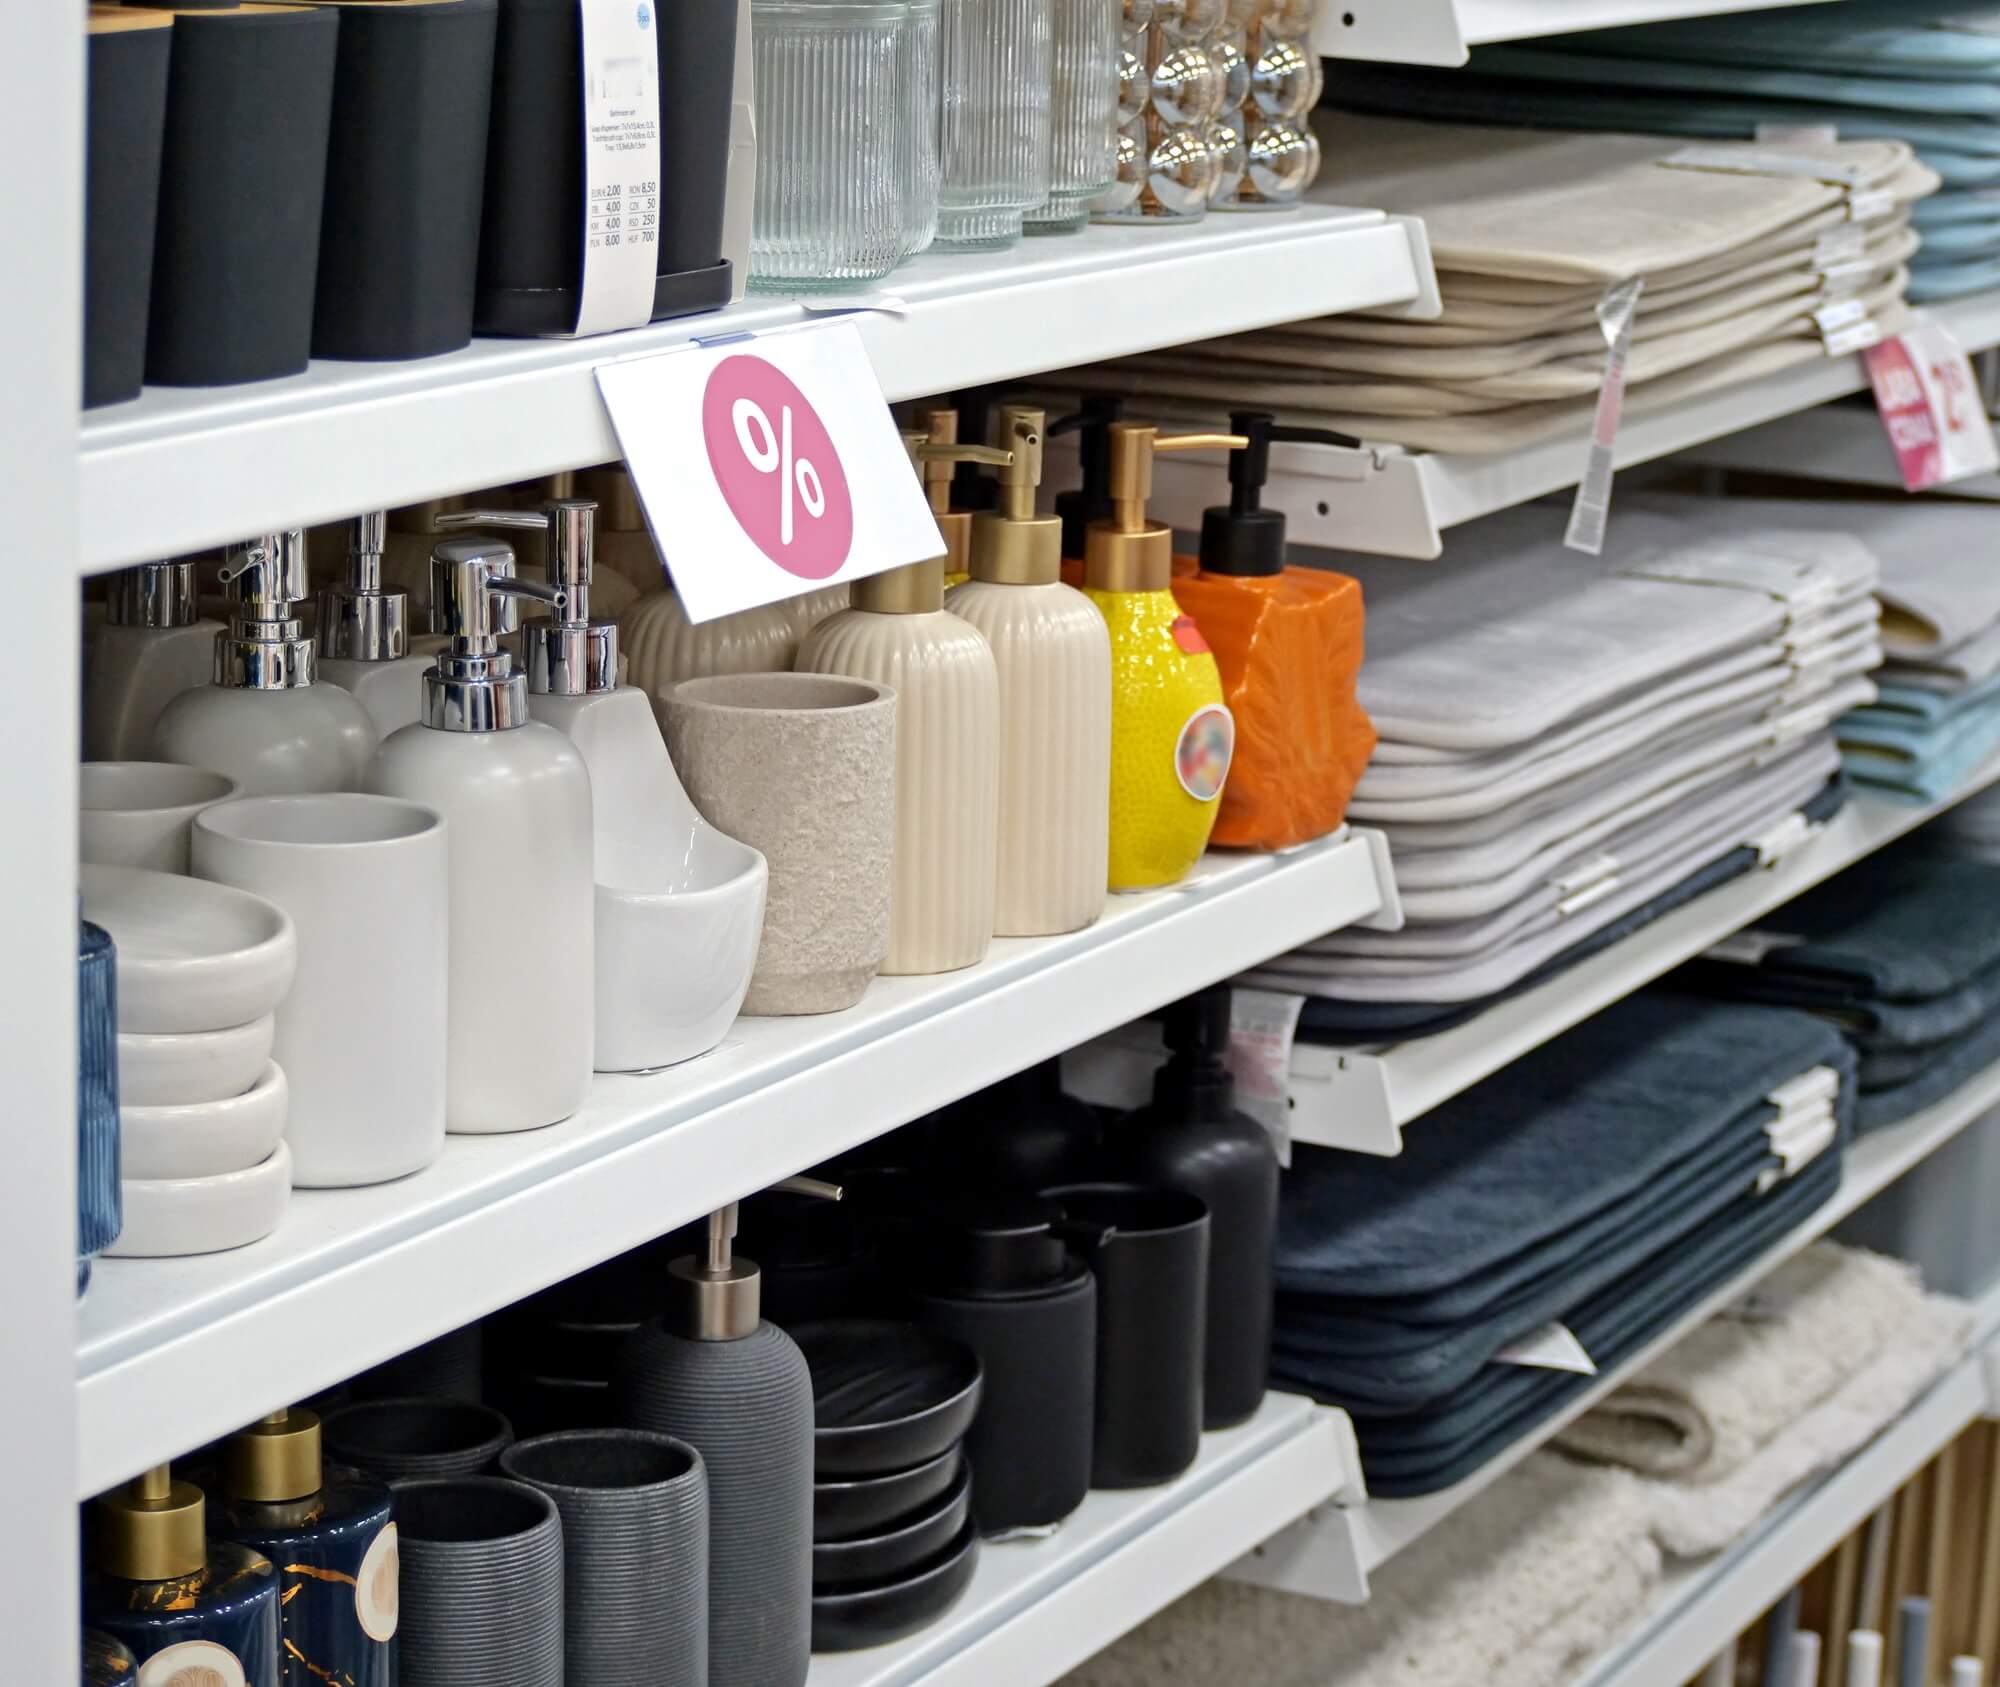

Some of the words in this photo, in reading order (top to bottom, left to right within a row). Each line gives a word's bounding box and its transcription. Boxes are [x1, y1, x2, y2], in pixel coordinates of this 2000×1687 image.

[607, 184, 621, 197] 2,00
[629, 185, 640, 194] RON
[641, 181, 656, 194] 8,50
[606, 201, 621, 213] 4,00
[647, 197, 656, 209] 50
[606, 217, 621, 230] 4,00
[642, 214, 656, 226] 250
[605, 234, 621, 247] 8,00
[642, 230, 655, 243] 700
[732, 398, 825, 545] %
